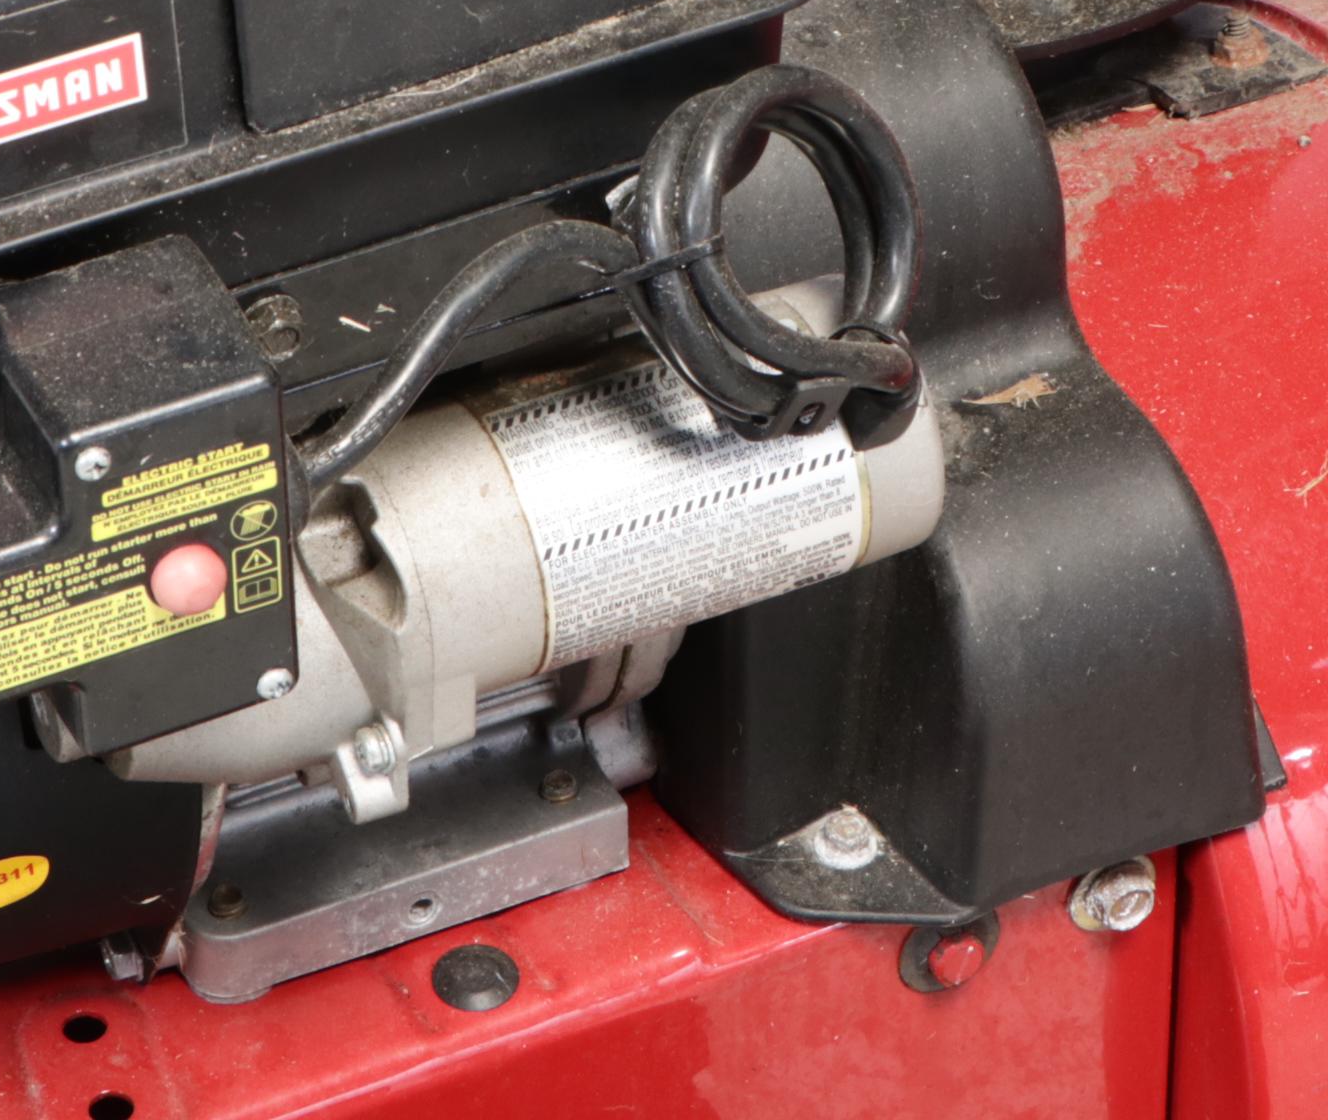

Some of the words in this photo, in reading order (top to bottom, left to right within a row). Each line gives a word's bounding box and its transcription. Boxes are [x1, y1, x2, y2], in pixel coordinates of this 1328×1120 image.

[495, 414, 554, 444] WARNING
[122, 456, 193, 487] ELECTRIC
[197, 442, 243, 464] START
[107, 470, 183, 503] DÉMARREUR
[3, 569, 33, 587] start
[44, 560, 61, 574] Do
[64, 553, 84, 567] not
[87, 546, 108, 560] run
[111, 531, 152, 552] starter
[155, 521, 186, 538] more
[189, 511, 217, 528] than
[548, 555, 568, 571] FOR
[571, 538, 618, 563] ELECTRIC
[622, 523, 664, 546] STARTER
[10, 582, 24, 594] at
[26, 564, 80, 589] intervals
[84, 558, 97, 570] of
[10, 597, 40, 615] does
[42, 590, 63, 605] not
[65, 579, 98, 598] start,
[101, 563, 145, 586] consult
[25, 585, 44, 600] On
[54, 579, 62, 590] 5
[65, 561, 118, 586] seconds
[122, 552, 144, 568] Off.
[19, 598, 69, 621] manual.
[555, 613, 583, 629] POUR
[586, 608, 598, 618] LE
